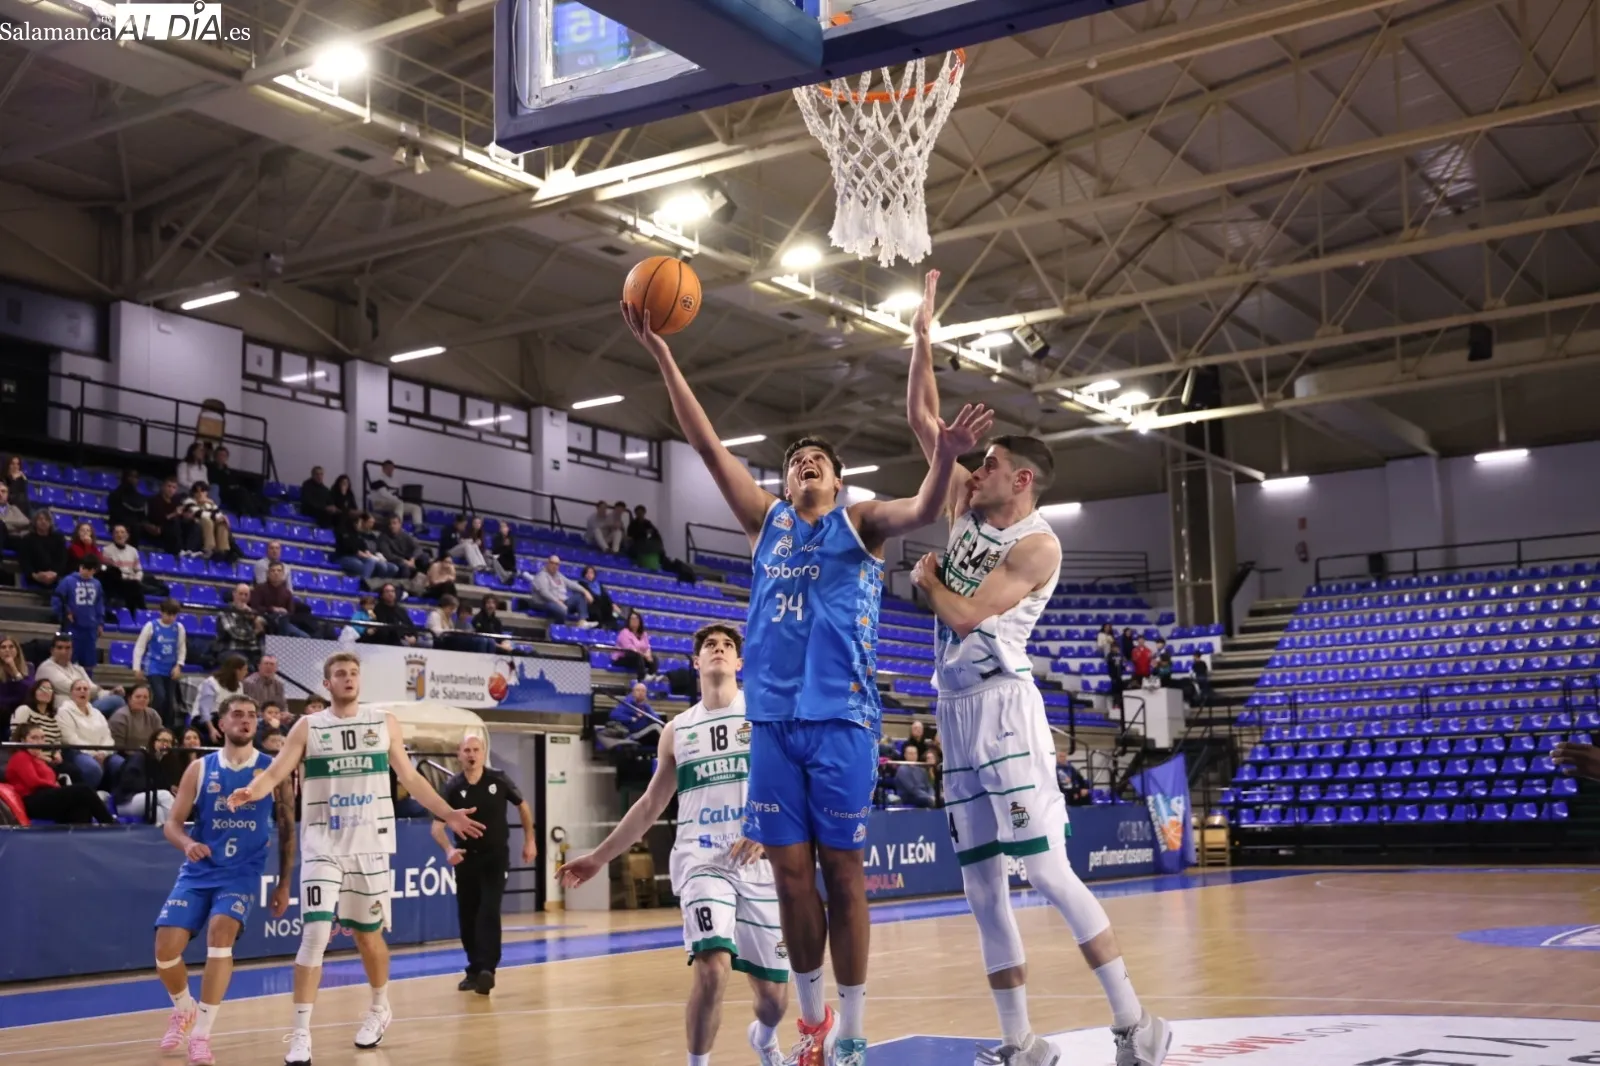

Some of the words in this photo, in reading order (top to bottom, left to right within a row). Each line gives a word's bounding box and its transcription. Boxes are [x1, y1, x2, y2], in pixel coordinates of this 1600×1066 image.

[75, 587, 96, 605] 23
[771, 592, 803, 622] 34
[430, 671, 485, 686] Ayuntamiento
[430, 687, 439, 699] de
[442, 687, 485, 701] Salamanca
[341, 730, 357, 750] 10
[709, 724, 729, 752] 18
[327, 756, 374, 773] XIRIA
[693, 757, 748, 781] XIRIA
[329, 793, 373, 808] Calvo
[698, 804, 745, 825] Calv
[212, 818, 257, 832] Xoborg
[224, 838, 238, 857] 6
[886, 844, 896, 870] Y
[900, 835, 936, 865] LEÓN
[390, 856, 457, 898] LEÓN
[307, 886, 321, 907] 10
[696, 906, 714, 932] 18
